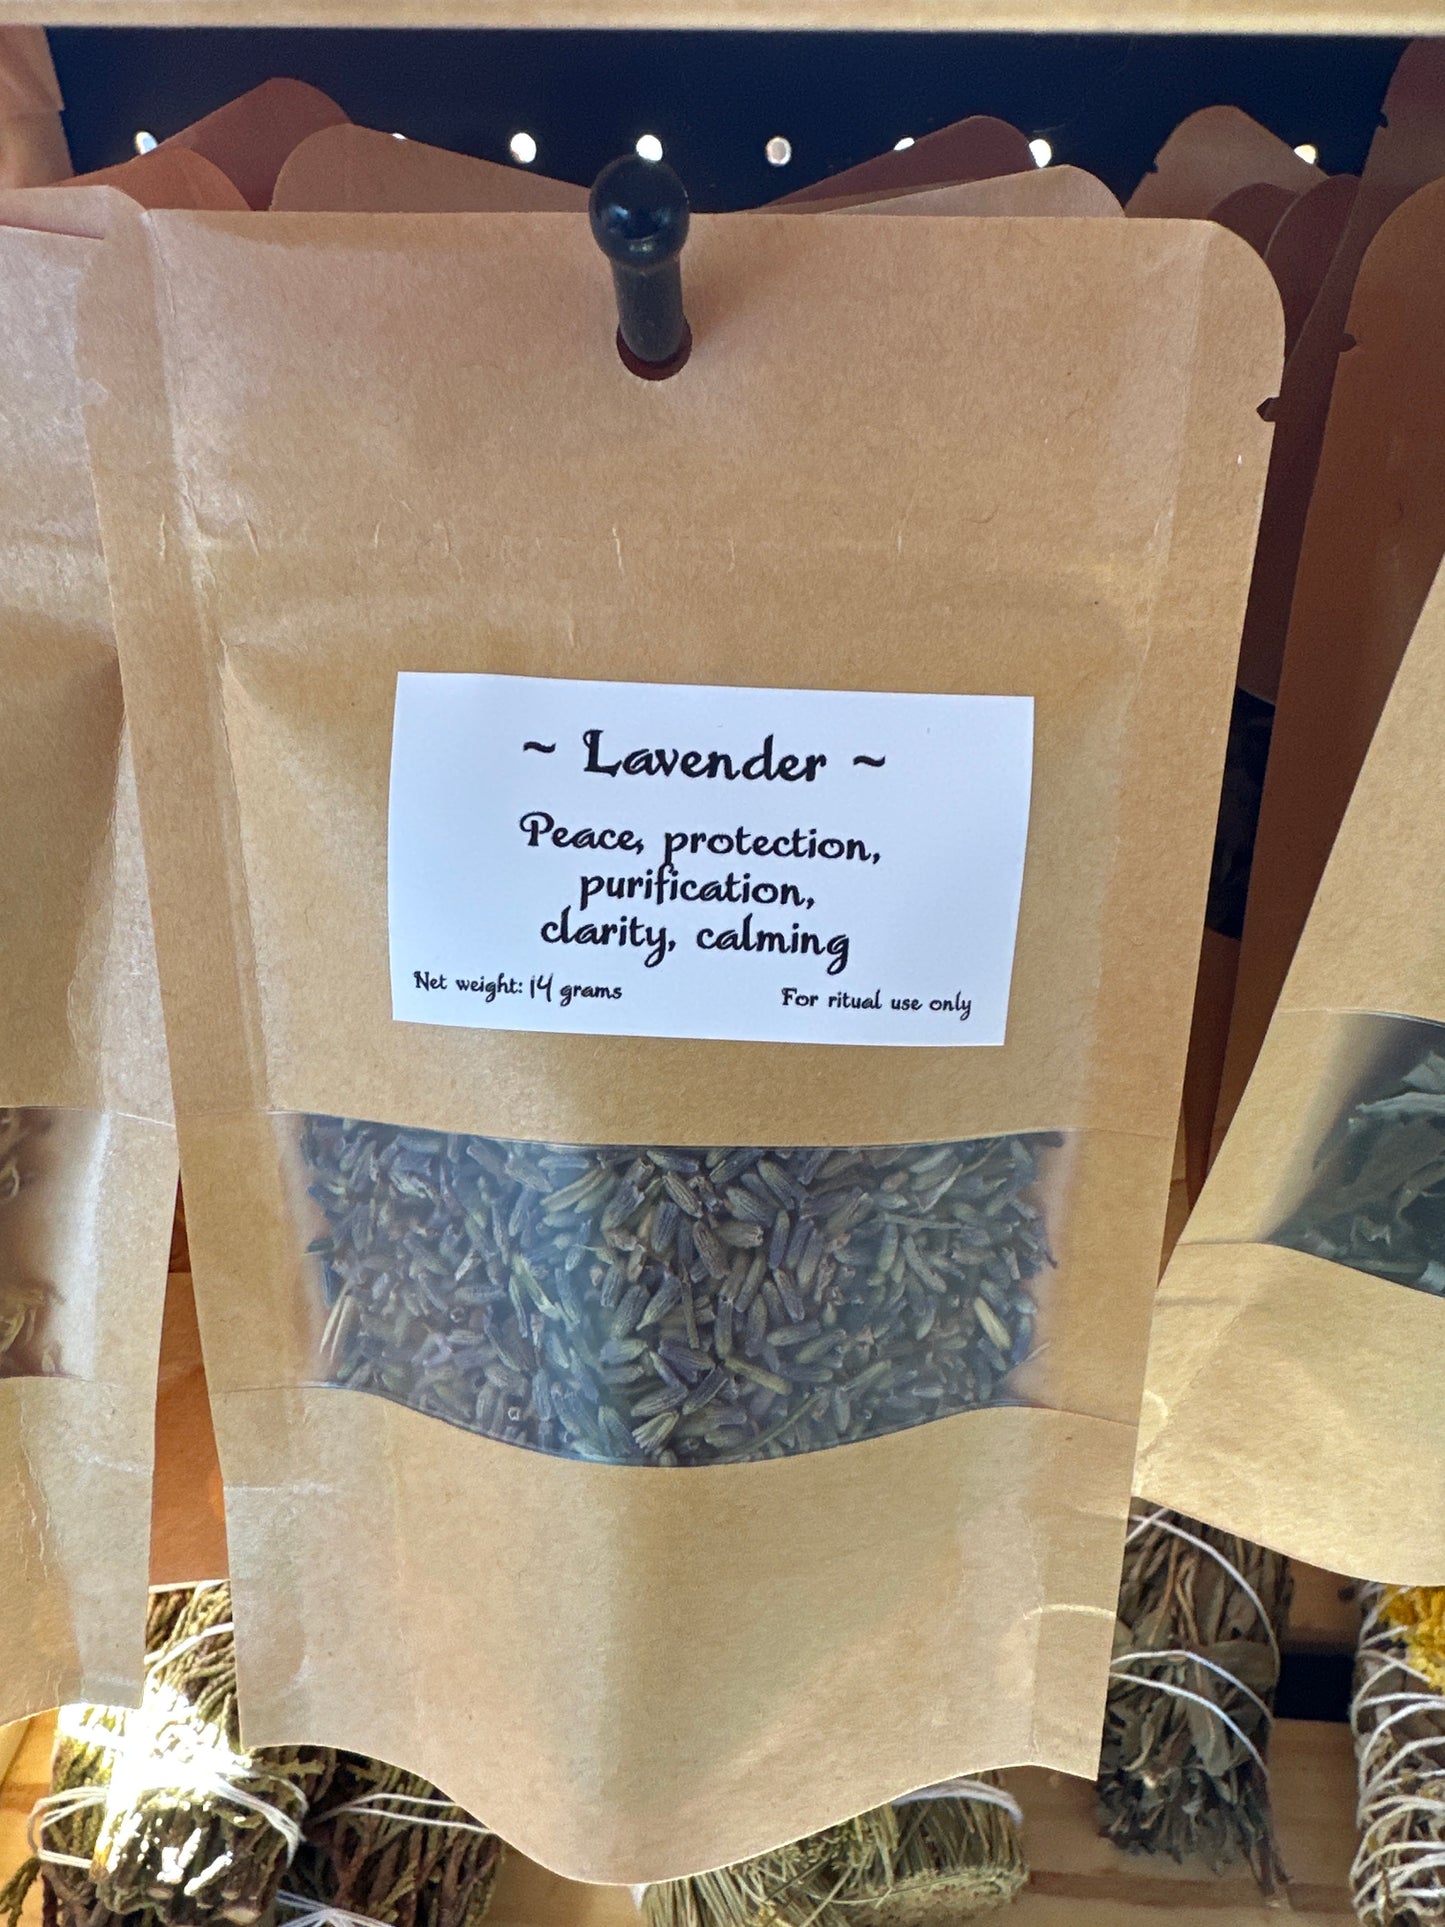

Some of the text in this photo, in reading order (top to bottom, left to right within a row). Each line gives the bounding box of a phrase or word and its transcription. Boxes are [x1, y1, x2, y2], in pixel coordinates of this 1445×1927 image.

[583, 729, 827, 783] Lavender
[519, 811, 881, 868] Peace, protection,
[579, 863, 815, 912] purification,
[540, 904, 850, 976] clarity, calming
[413, 970, 623, 1007] Net weight: 14 grams
[781, 987, 972, 1021] For ritual use only
